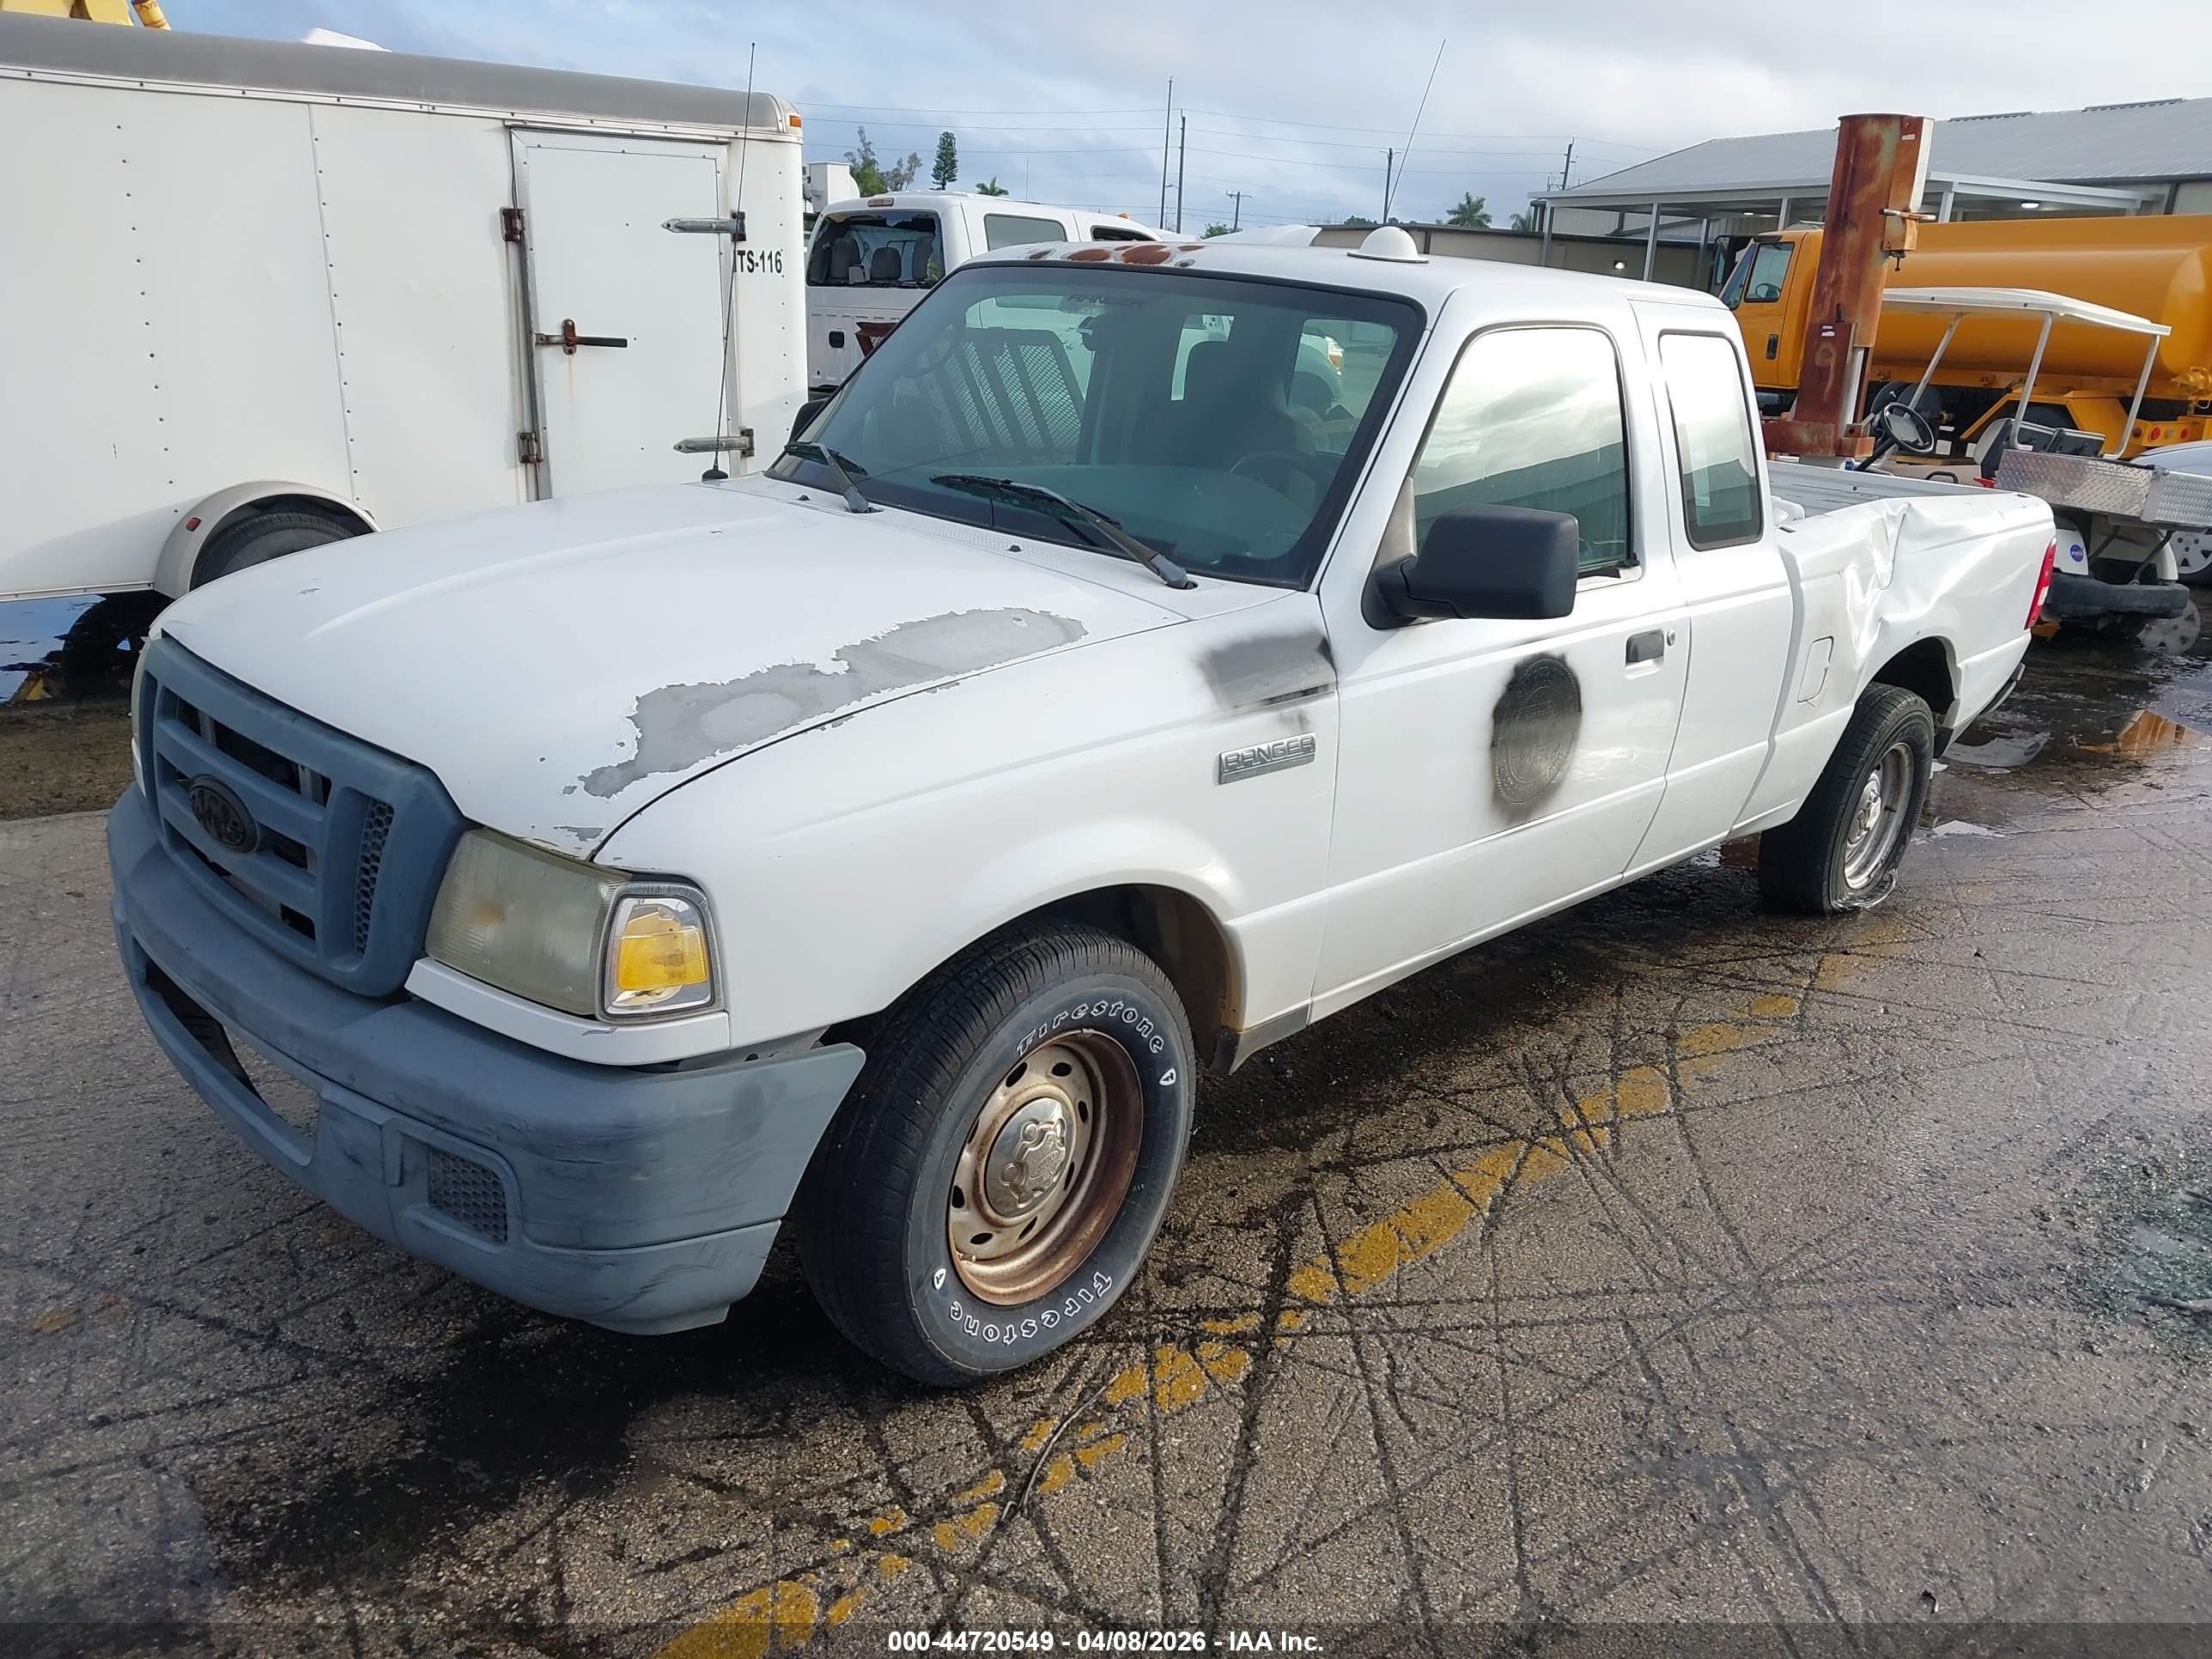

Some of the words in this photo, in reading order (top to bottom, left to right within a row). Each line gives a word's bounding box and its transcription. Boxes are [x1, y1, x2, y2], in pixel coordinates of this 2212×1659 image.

[1223, 735, 1315, 772] RANGER
[1016, 1000, 1164, 1057] Firestone
[950, 1271, 1113, 1346] Firestone
